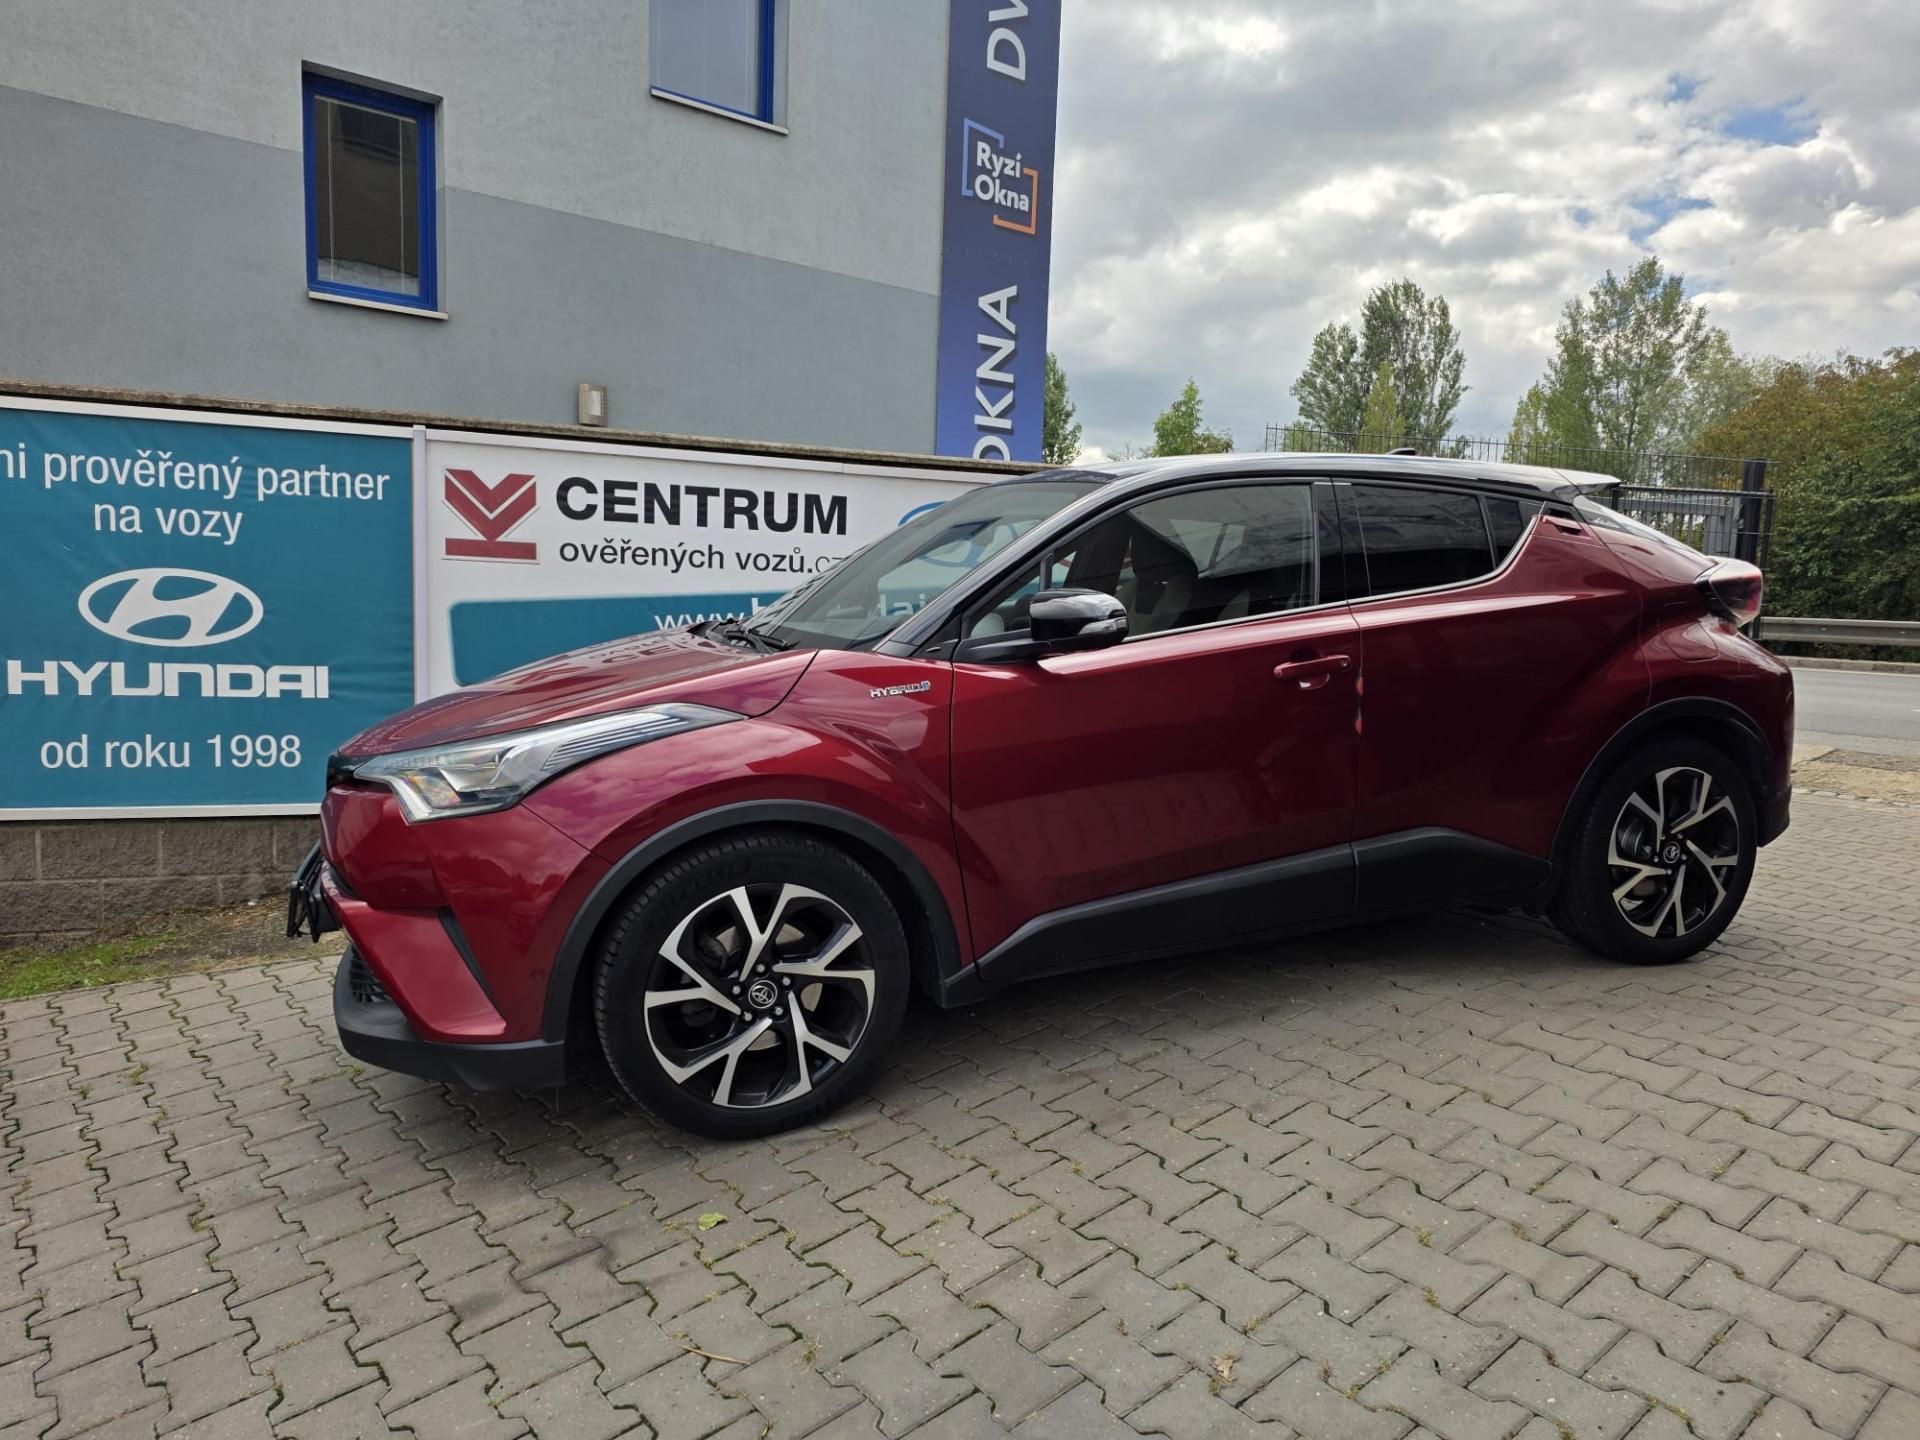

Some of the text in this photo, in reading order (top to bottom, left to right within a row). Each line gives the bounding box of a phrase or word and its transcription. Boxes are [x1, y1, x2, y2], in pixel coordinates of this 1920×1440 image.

[977, 141, 1022, 178] Ryzí
[975, 175, 1029, 212] Okna
[44, 450, 242, 500] prověřený
[257, 464, 390, 501] partner
[94, 503, 243, 545] na vozy
[556, 476, 848, 535] CENTRUM
[559, 538, 842, 573] ověřených vozů.c
[7, 659, 329, 699] HYUNDAI
[40, 734, 302, 768] od roku 1998
